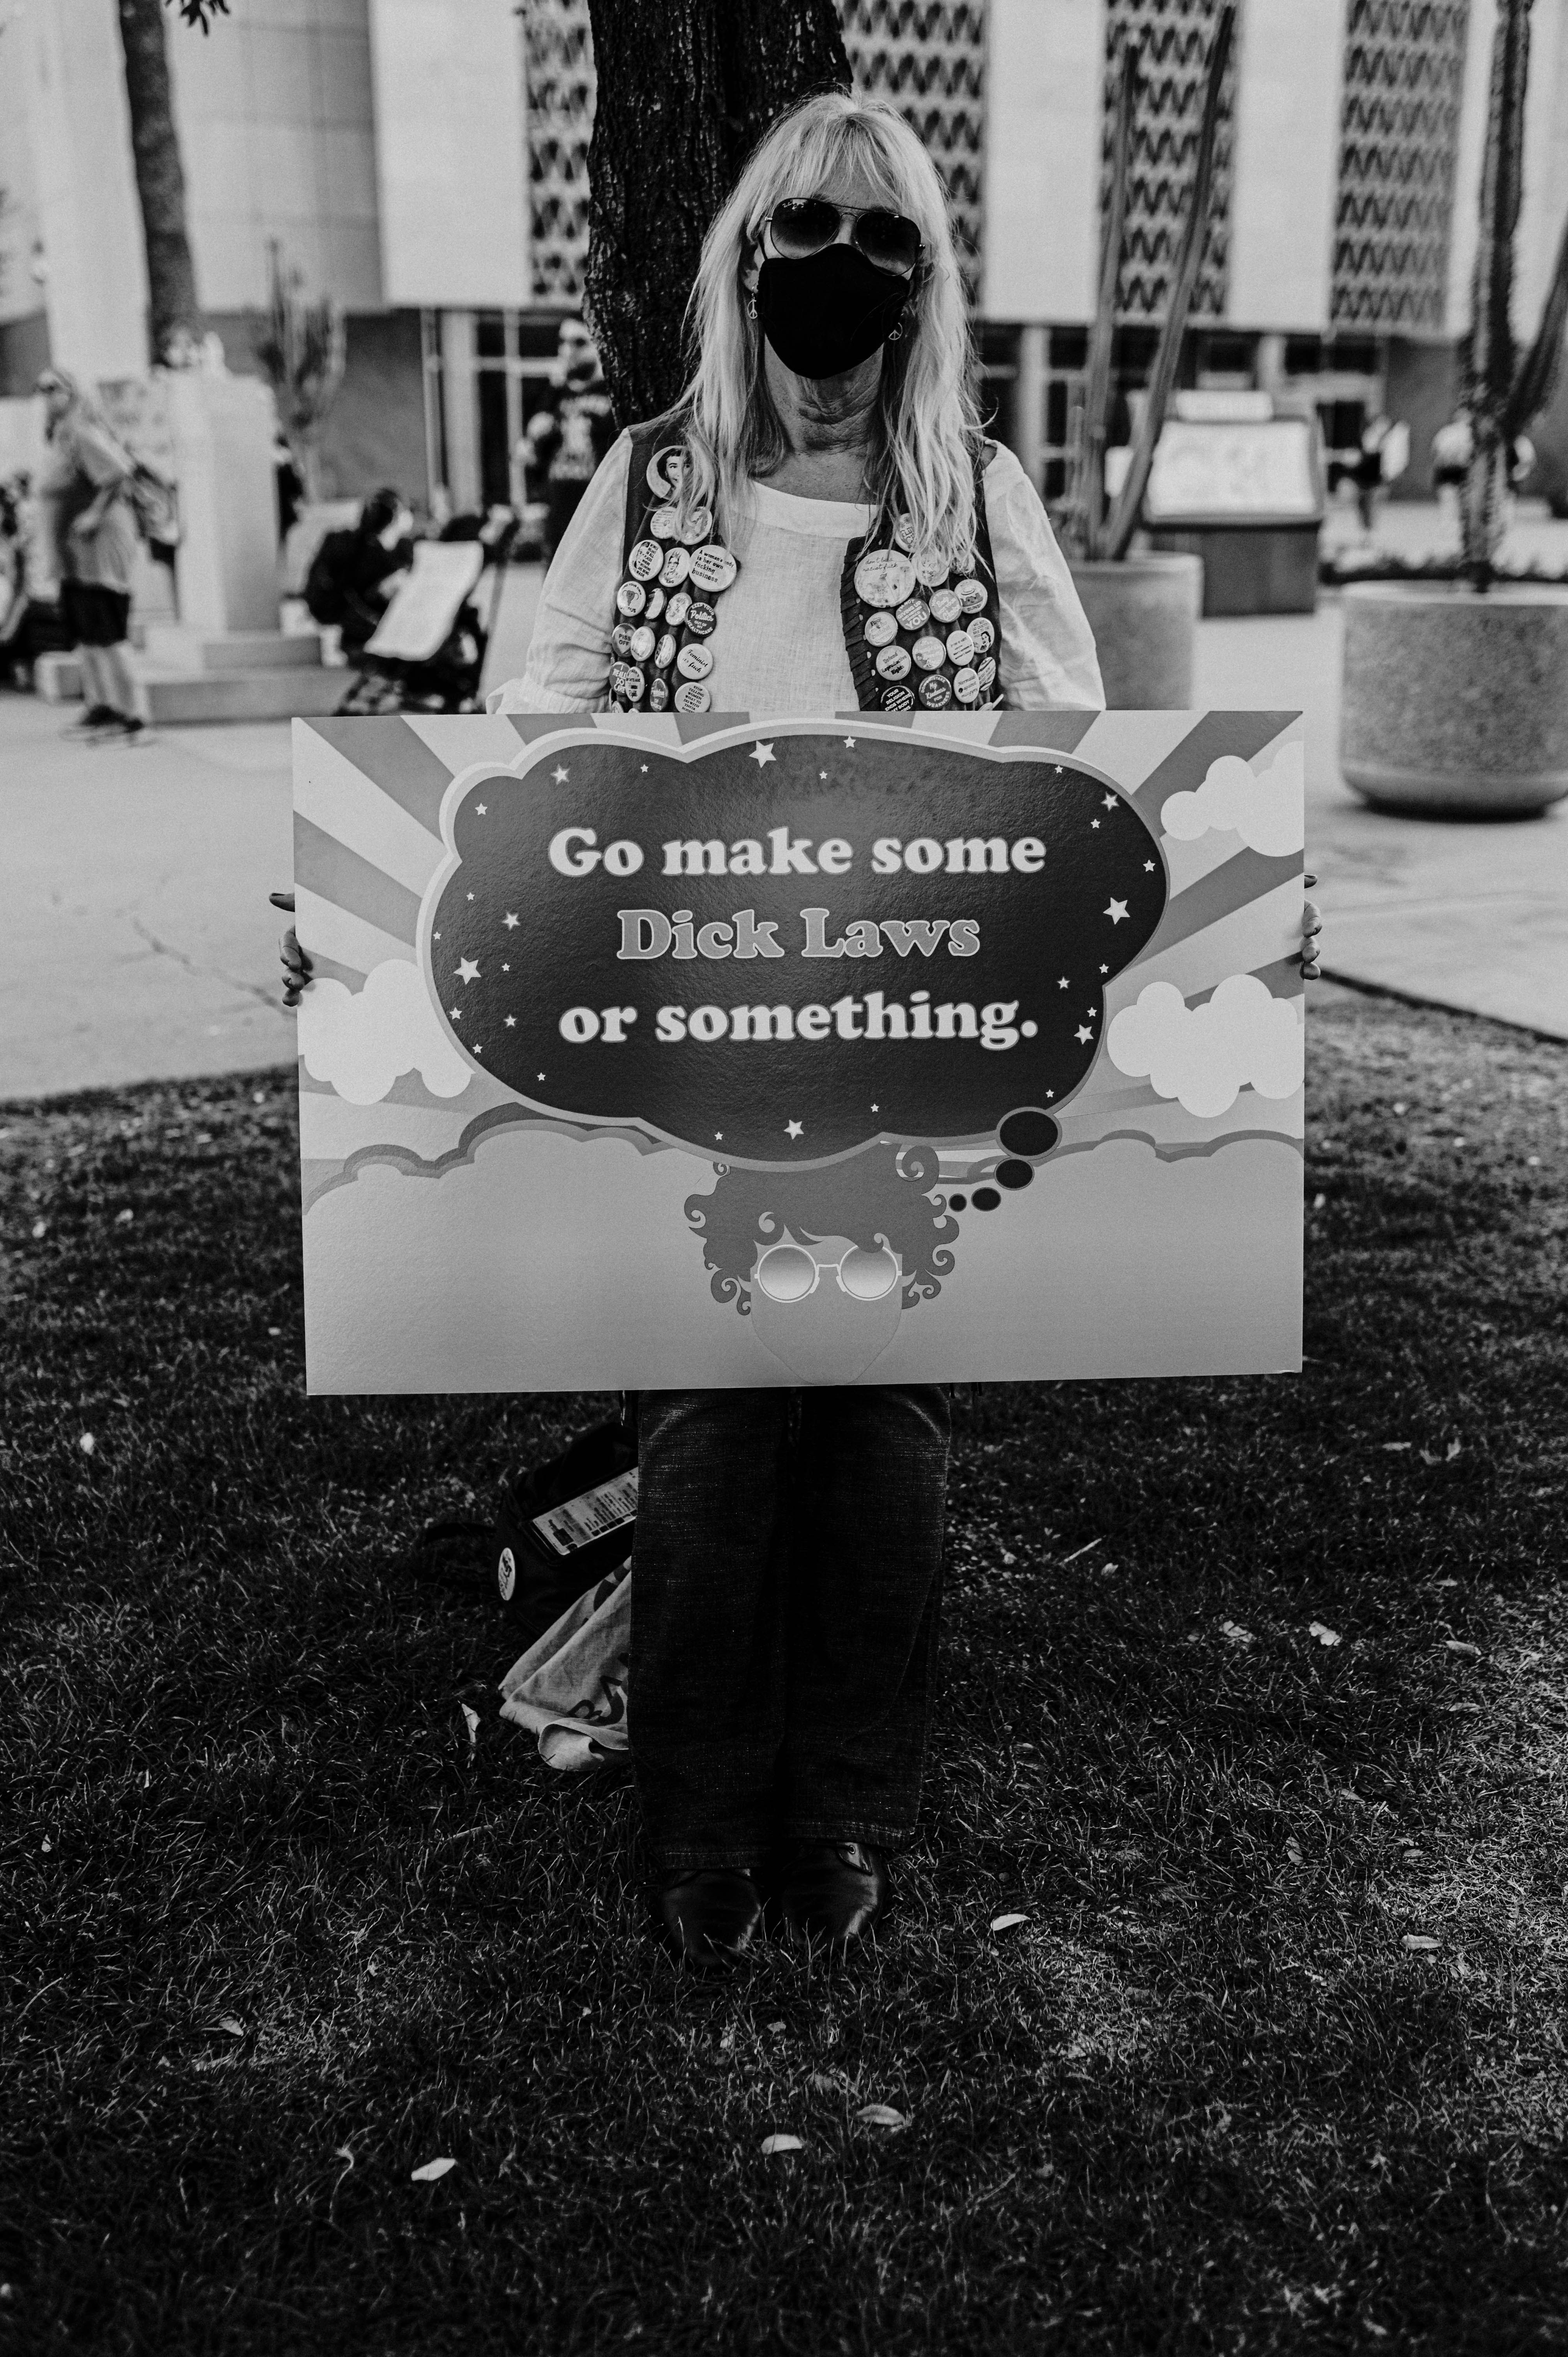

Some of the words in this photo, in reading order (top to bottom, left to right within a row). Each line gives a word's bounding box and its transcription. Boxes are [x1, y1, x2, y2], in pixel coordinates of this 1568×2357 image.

[704, 553, 723, 562] woman's
[695, 561, 715, 575] fucking
[692, 568, 719, 583] business.
[690, 610, 714, 622] Politics
[703, 604, 714, 615] YOUR
[897, 606, 915, 619] GIVING
[905, 611, 927, 629] YOU
[687, 620, 713, 635] HEALTHCARE
[687, 649, 708, 667] Feminist
[881, 655, 907, 673] Reproductive
[883, 651, 898, 664] Defend
[688, 662, 702, 673] fuck
[891, 665, 904, 675] Rights
[613, 669, 627, 680] REALL
[616, 677, 624, 686] DO
[688, 691, 702, 700] WOMEN
[689, 687, 705, 697] TELLING
[886, 689, 899, 698] YOUR
[886, 691, 905, 705] RELIGION
[925, 687, 946, 700] Kindness
[885, 702, 897, 711] ENDS
[896, 693, 911, 704] WHERE
[898, 700, 909, 709] BODY
[927, 691, 950, 708] WEAKNESS
[549, 827, 644, 877] Go
[662, 826, 853, 875] make
[871, 837, 1047, 874] some
[617, 909, 785, 959] Dick
[800, 908, 980, 958] Laws
[559, 1006, 637, 1043] or
[655, 990, 1038, 1050] something.
